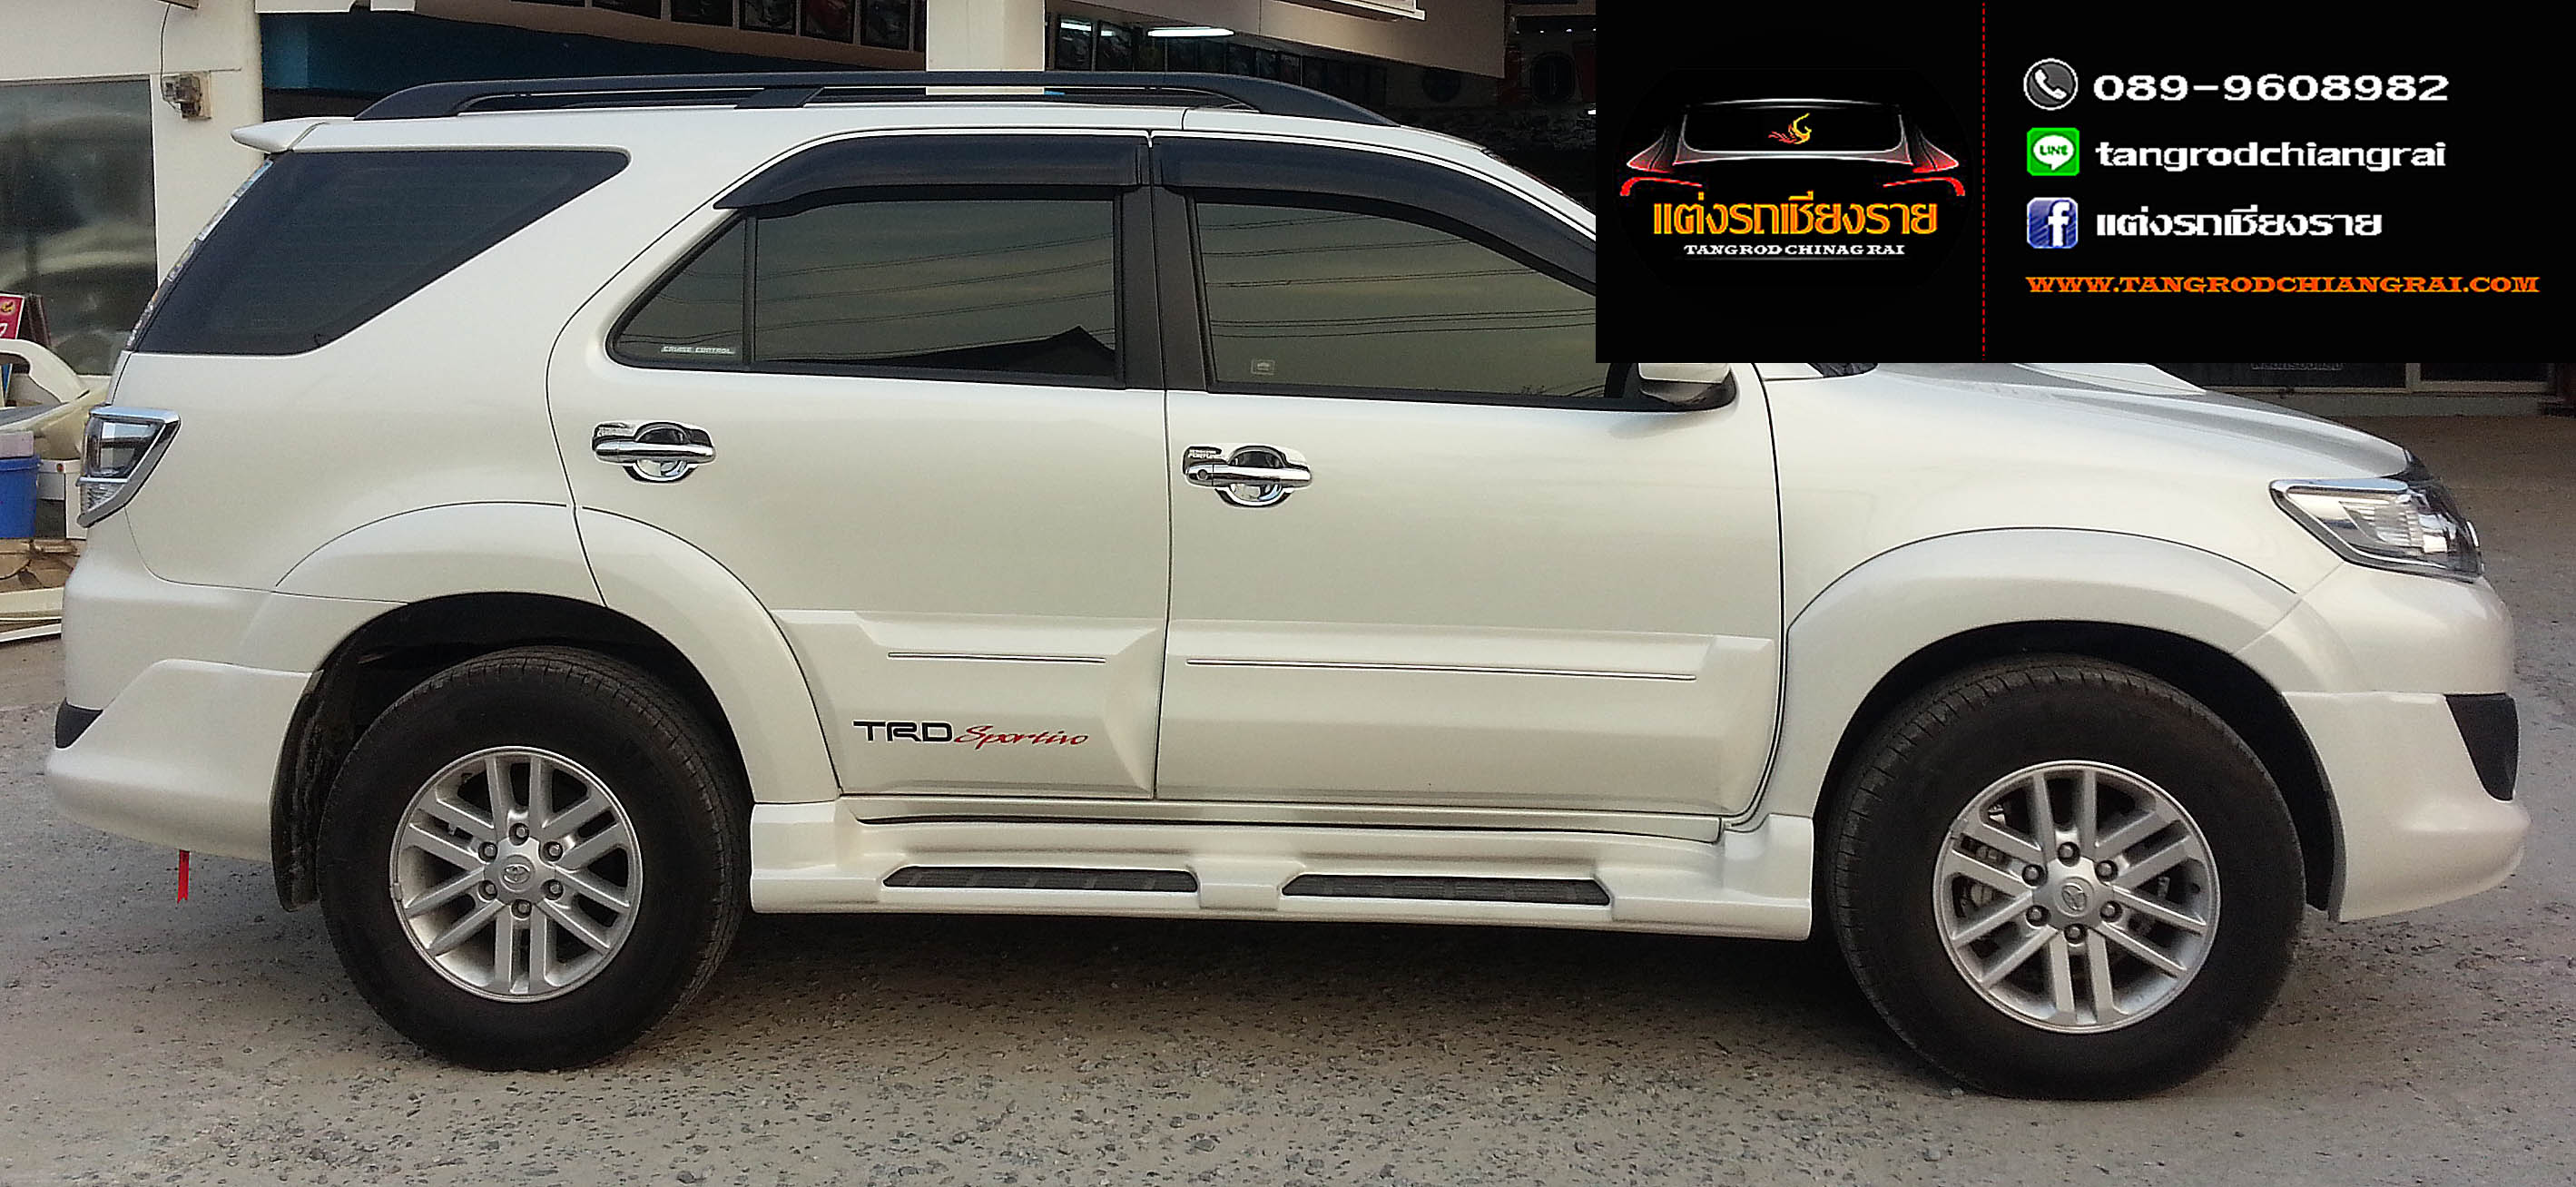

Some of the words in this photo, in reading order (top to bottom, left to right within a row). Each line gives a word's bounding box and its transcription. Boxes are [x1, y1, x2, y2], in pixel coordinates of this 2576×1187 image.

[694, 347, 736, 355] CONTROL
[852, 720, 953, 742] TRD
[953, 724, 1089, 750] Sportivo
